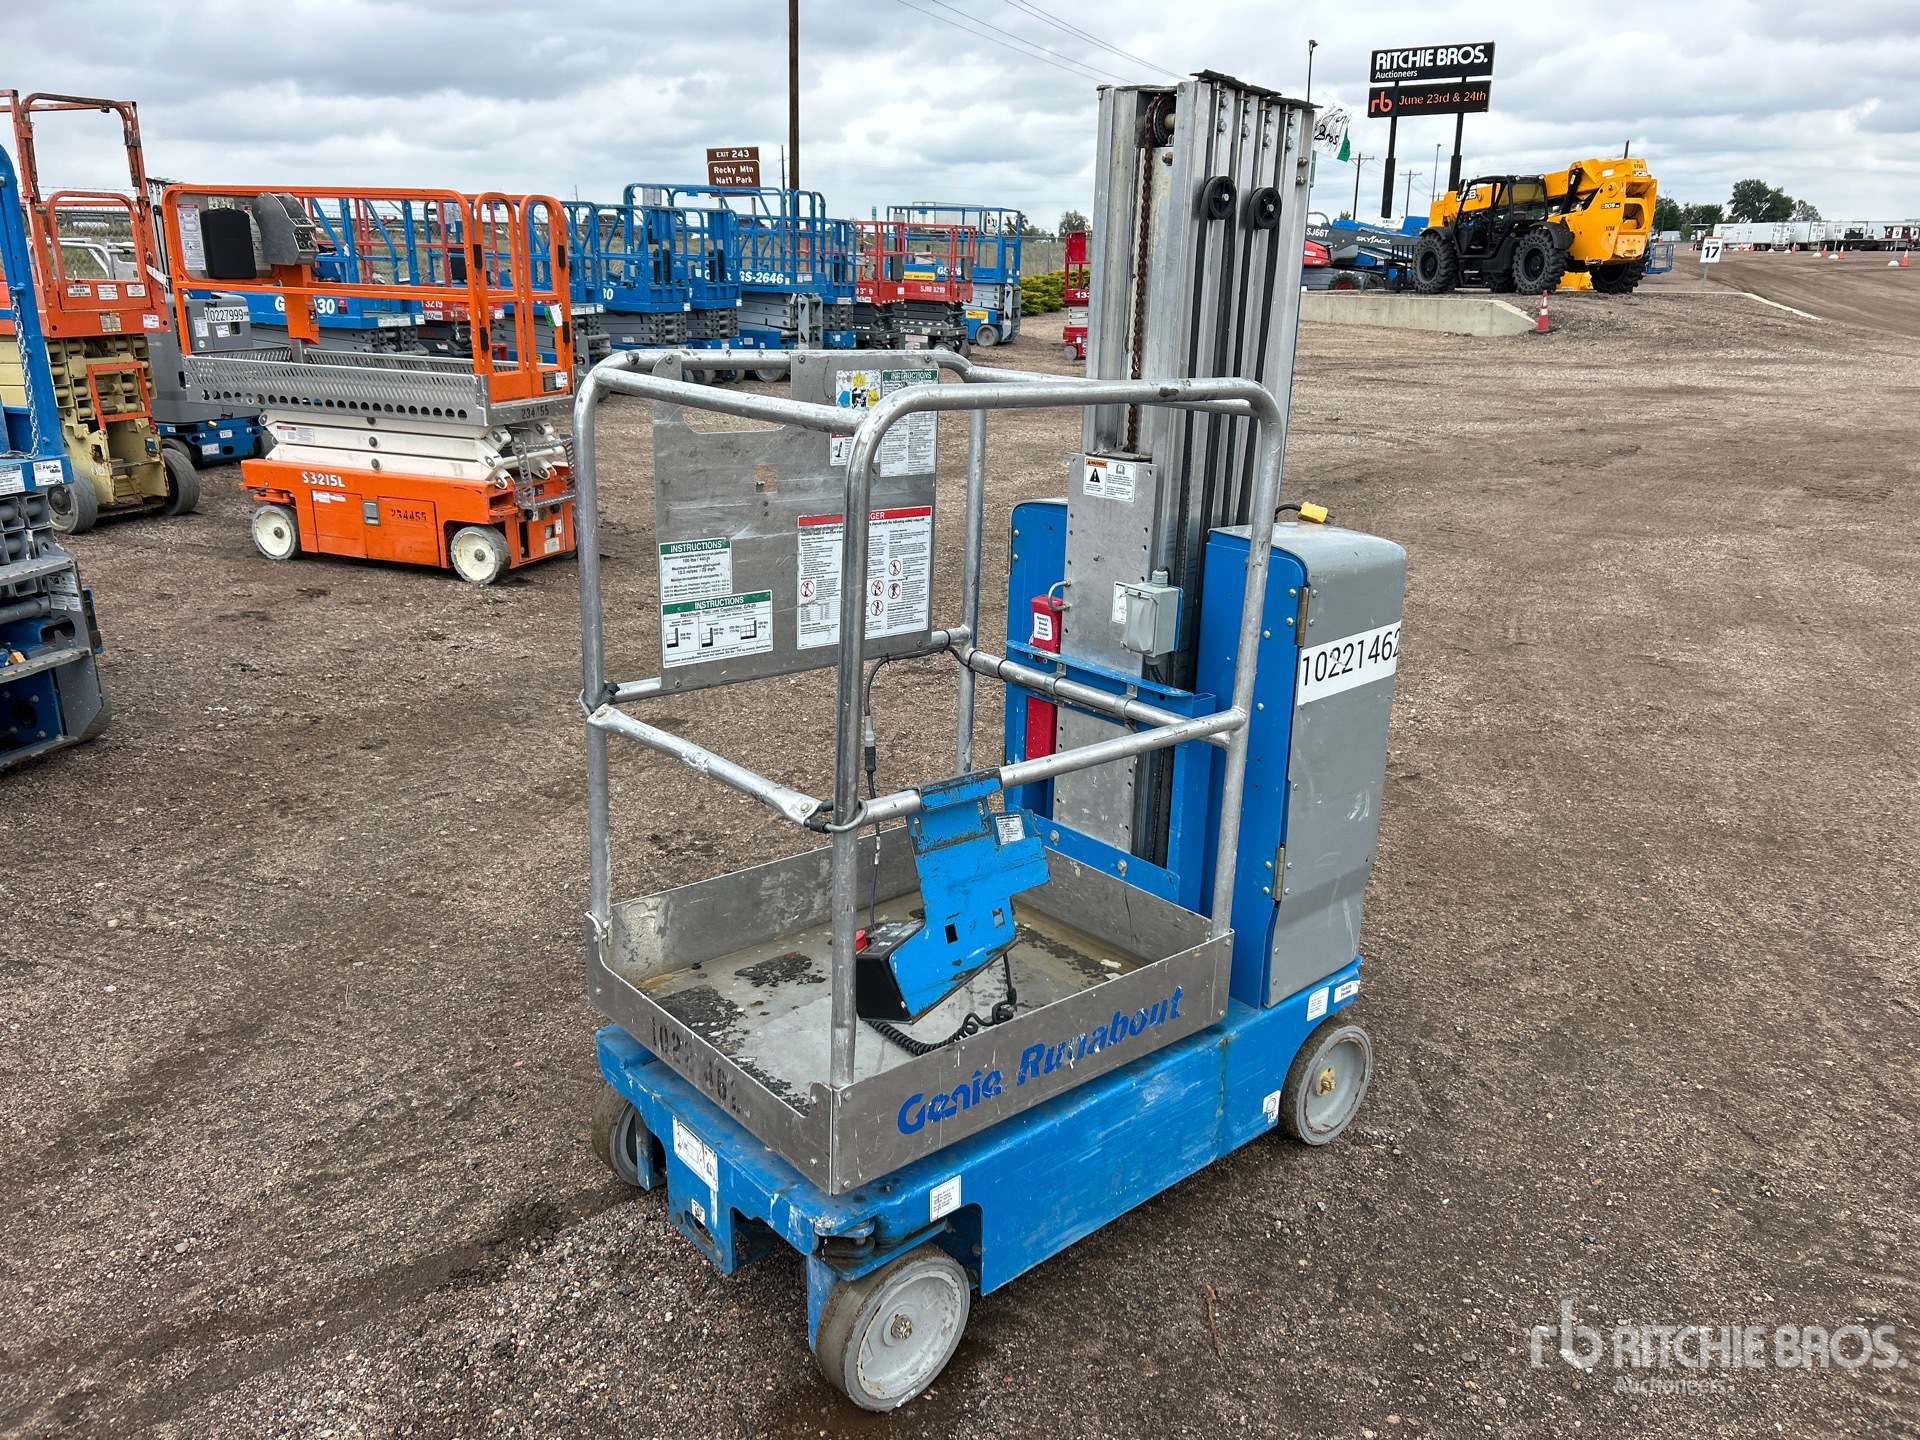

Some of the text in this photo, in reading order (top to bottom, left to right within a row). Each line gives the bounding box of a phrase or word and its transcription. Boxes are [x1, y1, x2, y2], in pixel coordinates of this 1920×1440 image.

[1375, 45, 1489, 71] RITCHIE BROS.
[1375, 70, 1418, 80] Auctioneers
[1370, 91, 1393, 113] rb
[1398, 90, 1487, 106] June 23rd & 24th
[731, 149, 750, 158] 243
[713, 165, 754, 175] Rocky Mtn
[735, 176, 753, 184] Park
[1456, 189, 1477, 202] JB
[1306, 227, 1330, 238] SJ66T
[1355, 234, 1391, 245] SKYJACK
[1704, 245, 1721, 259] 17
[739, 271, 784, 284] GS-2646
[932, 286, 946, 294] 3219
[205, 308, 244, 322] 10227999
[301, 471, 347, 488] S3215L
[868, 511, 885, 520] GER
[670, 540, 723, 553] INSTRUCTIONS
[694, 596, 744, 610] INSTRUCTIONS
[1302, 628, 1401, 686] 10221462
[897, 985, 1185, 1135] Genie Runabout
